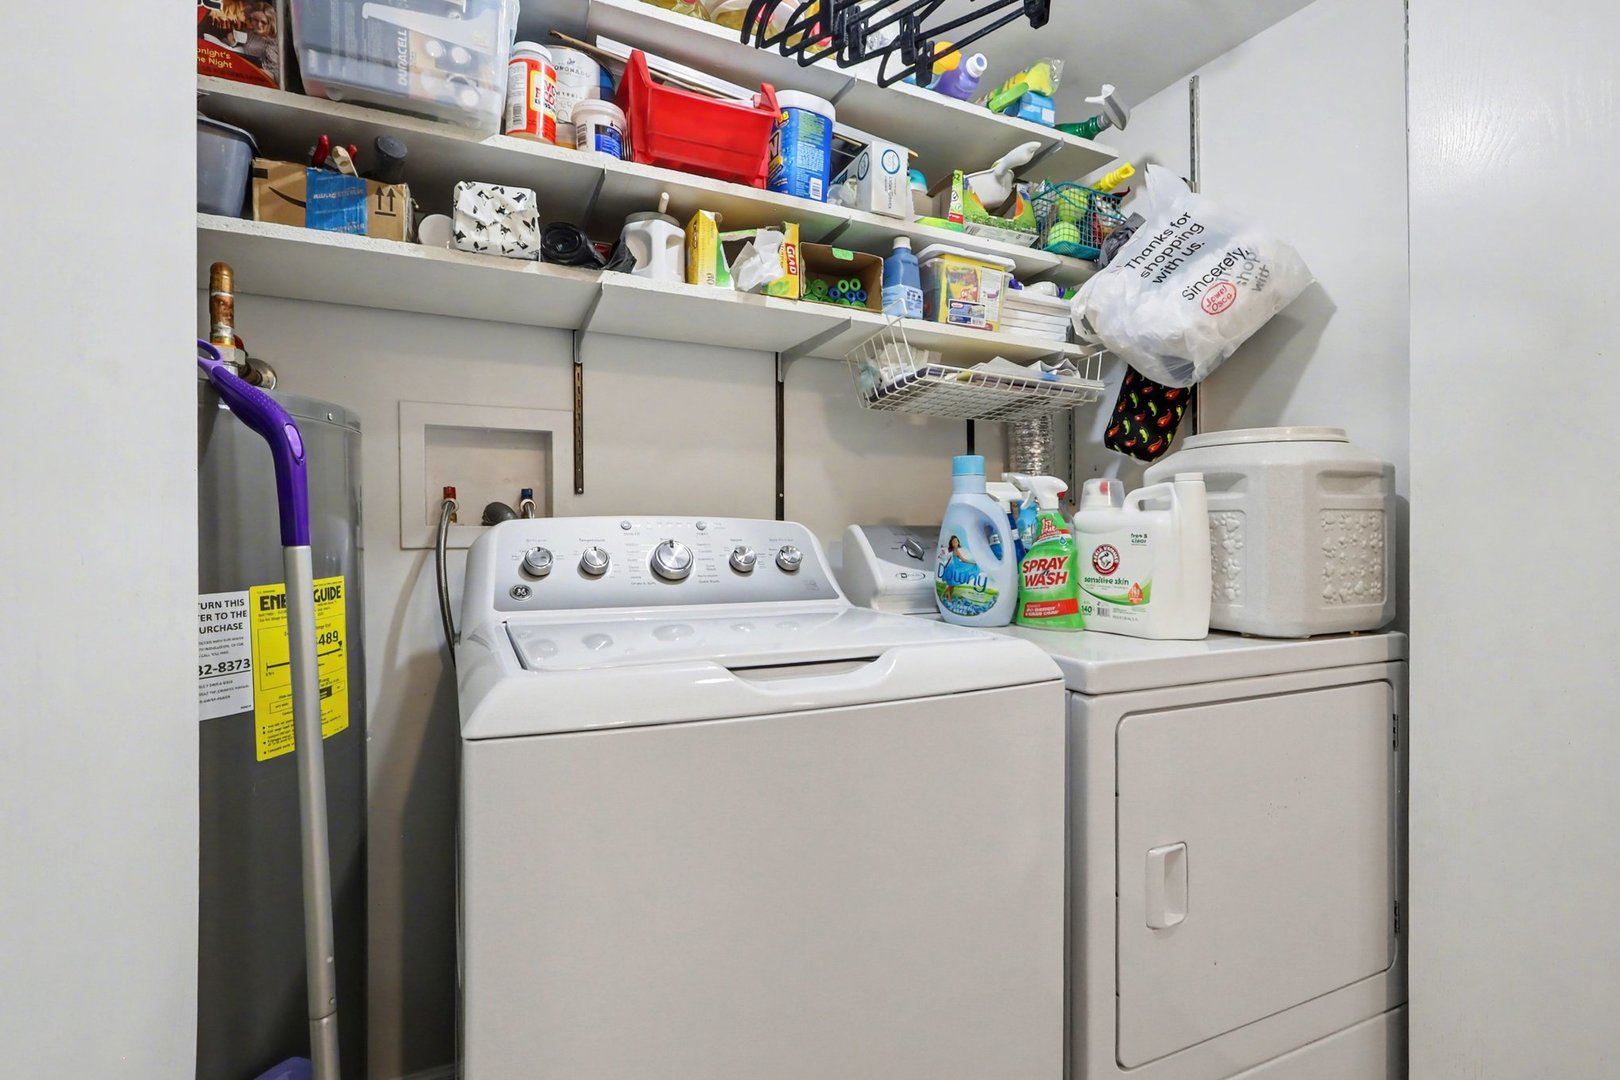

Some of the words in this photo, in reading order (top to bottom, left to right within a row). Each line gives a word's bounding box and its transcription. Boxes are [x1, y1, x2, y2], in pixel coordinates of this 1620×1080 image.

[208, 57, 233, 69] Night
[397, 28, 408, 87] DURACELL
[1124, 229, 1174, 269] Thanks
[1170, 212, 1192, 229] for
[786, 245, 797, 275] GLAD
[1140, 223, 1205, 279] shopping
[1152, 257, 1185, 284] with
[1181, 242, 1206, 257] us.
[1181, 247, 1250, 301] Sincerely,
[1022, 556, 1069, 574] SPRAY
[938, 556, 988, 593] Downy
[1024, 571, 1068, 588] WASH
[1084, 577, 1114, 585] sensitive
[1114, 577, 1130, 586] skin
[313, 585, 342, 603] GUIDE
[198, 600, 222, 611] URN
[224, 598, 245, 608] THIS
[1081, 605, 1093, 613] 140
[198, 614, 213, 622] ER
[215, 612, 228, 621] TO
[230, 609, 248, 619] THE
